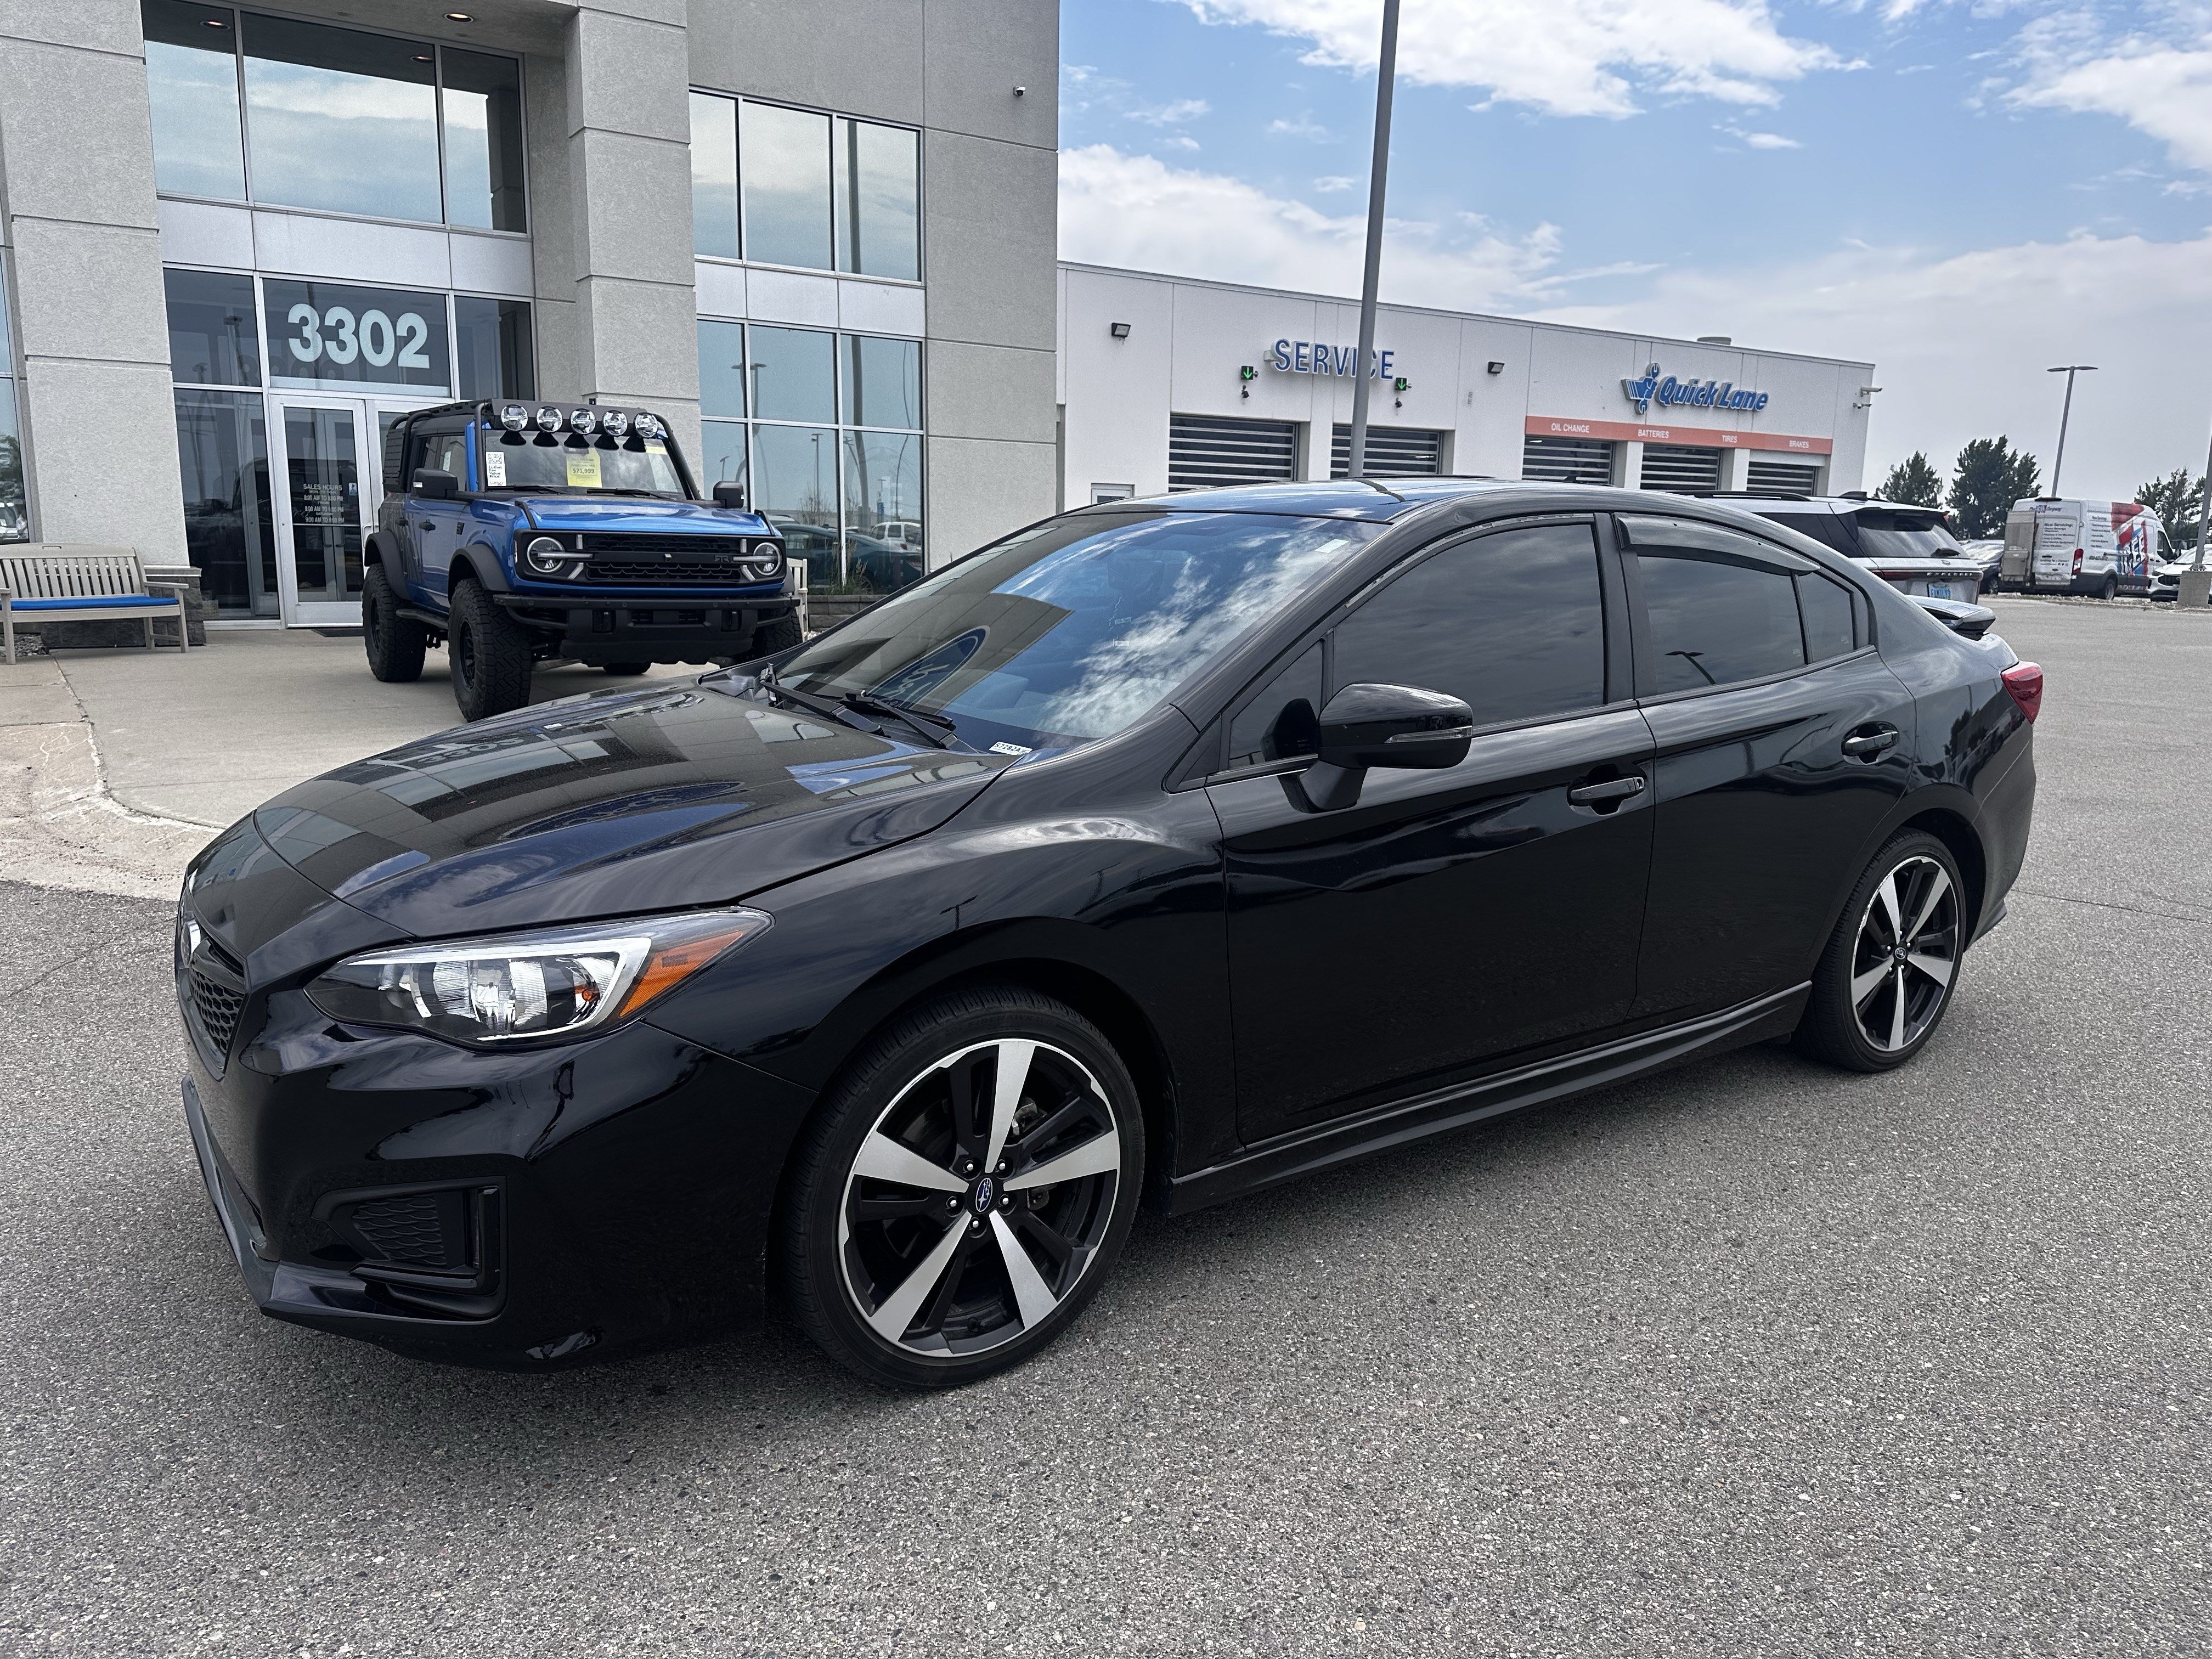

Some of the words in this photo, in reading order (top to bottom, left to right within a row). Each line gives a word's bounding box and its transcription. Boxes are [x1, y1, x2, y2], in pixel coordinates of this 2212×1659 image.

[288, 303, 430, 368] 3302
[1658, 375, 1720, 407] Quick
[1717, 382, 1769, 411] Lane
[1551, 423, 1562, 431] OIL
[1563, 424, 1590, 433] CHANGE
[1638, 429, 1669, 439] BATTERIES
[1722, 435, 1738, 443] TIRES
[1789, 440, 1809, 449] BRAKES
